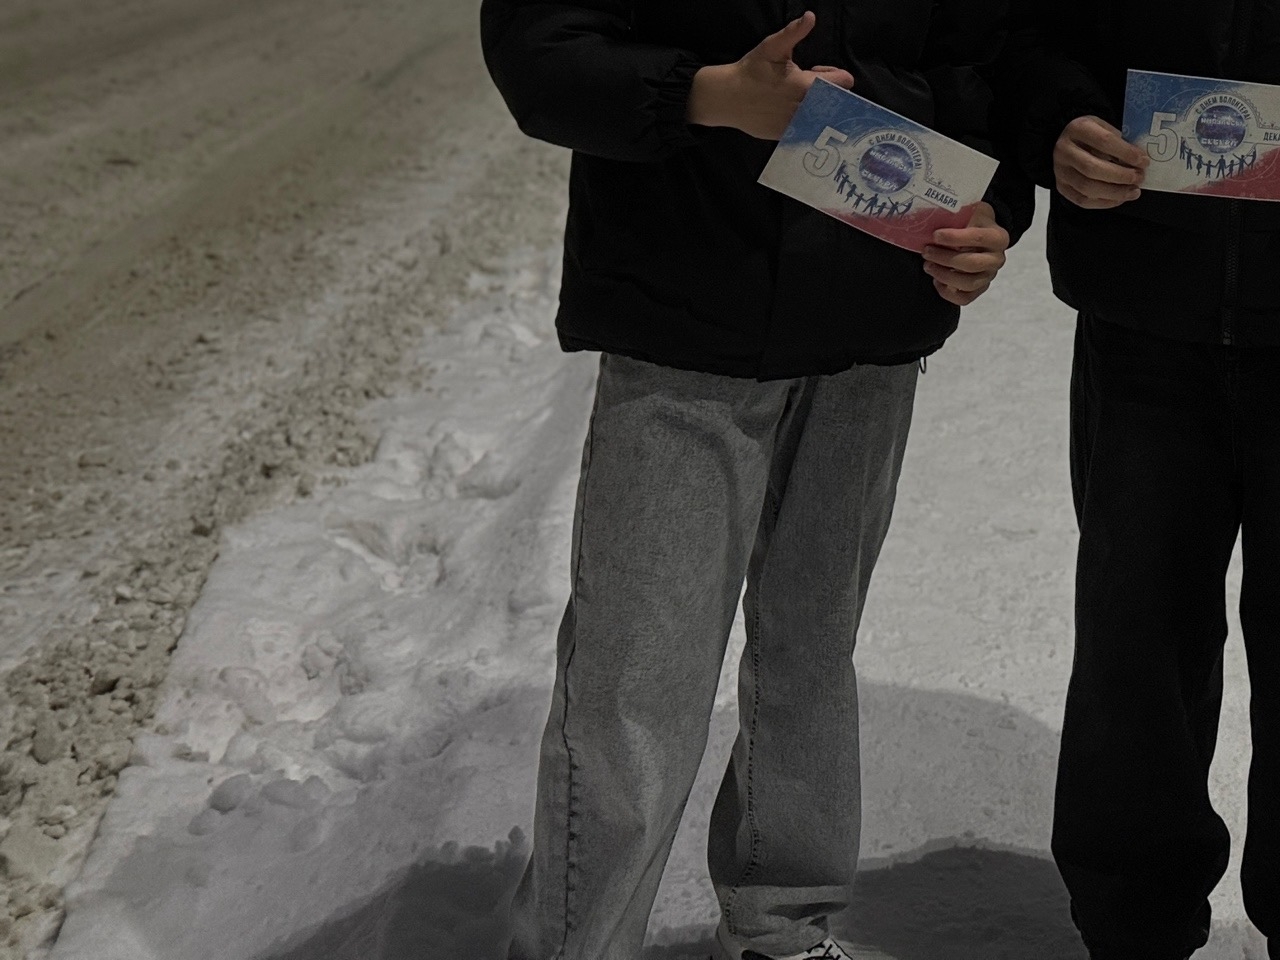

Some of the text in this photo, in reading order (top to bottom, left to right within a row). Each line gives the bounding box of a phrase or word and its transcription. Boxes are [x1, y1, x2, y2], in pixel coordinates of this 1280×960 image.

[802, 125, 849, 178] 5
[1146, 111, 1178, 163] 5
[924, 187, 958, 209] ДЕКАБРЯ
